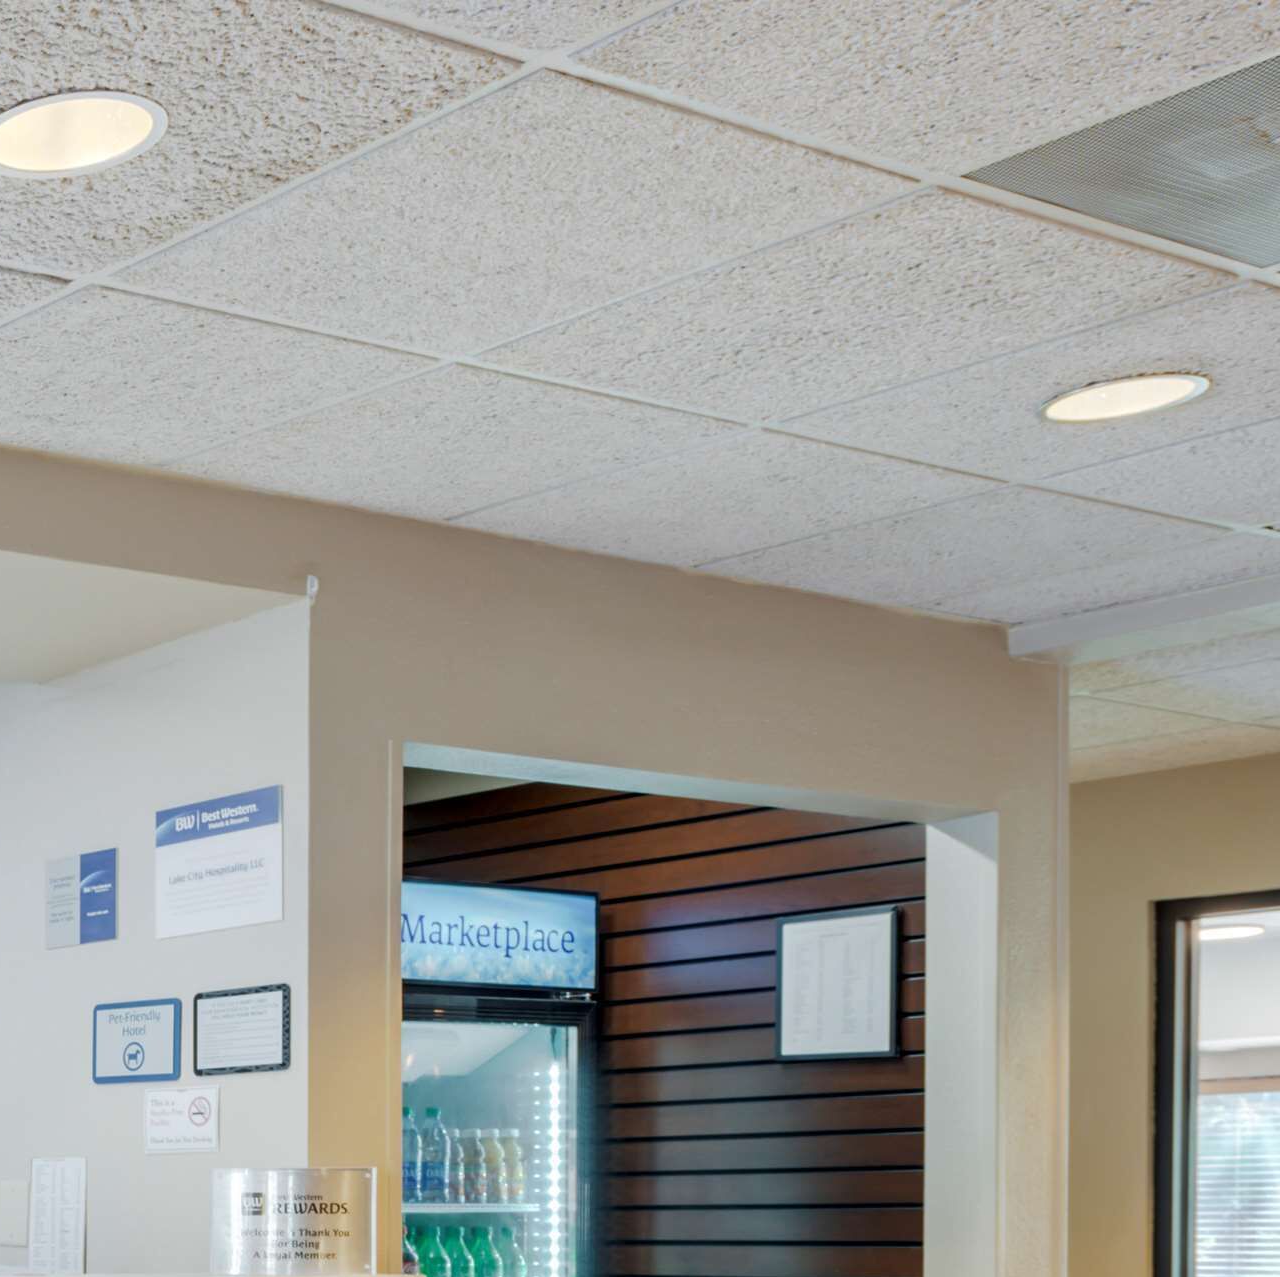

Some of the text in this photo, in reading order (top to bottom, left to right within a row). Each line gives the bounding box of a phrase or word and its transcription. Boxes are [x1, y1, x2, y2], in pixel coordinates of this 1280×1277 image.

[175, 814, 195, 832] BW
[201, 810, 220, 823] Best
[401, 913, 575, 958] Marketplace
[109, 1010, 161, 1025] Pet-Friendly
[122, 1025, 146, 1036] Hotel
[273, 1202, 349, 1215] REWARDS
[299, 1228, 330, 1237] Thank
[333, 1228, 350, 1237] You
[291, 1240, 321, 1250] Being
